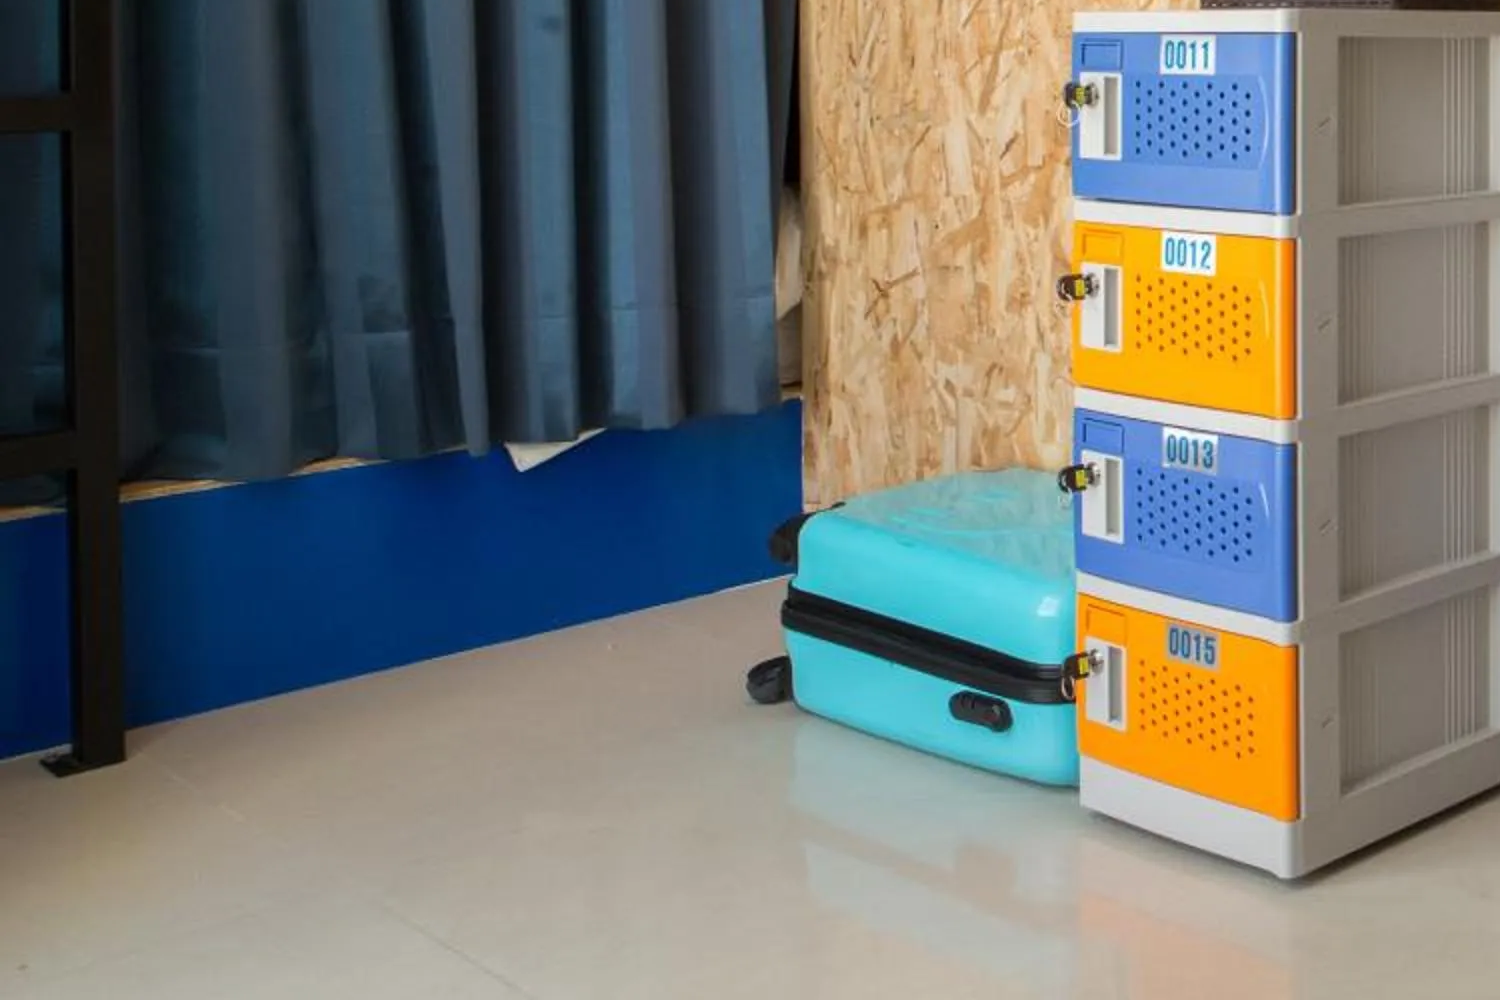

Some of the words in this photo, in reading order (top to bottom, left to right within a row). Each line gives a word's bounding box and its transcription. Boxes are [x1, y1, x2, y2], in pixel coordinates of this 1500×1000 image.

[1164, 39, 1210, 70] 0011
[1164, 237, 1212, 269] 0012
[1166, 435, 1214, 469] 0013
[1169, 627, 1216, 665] 0015
